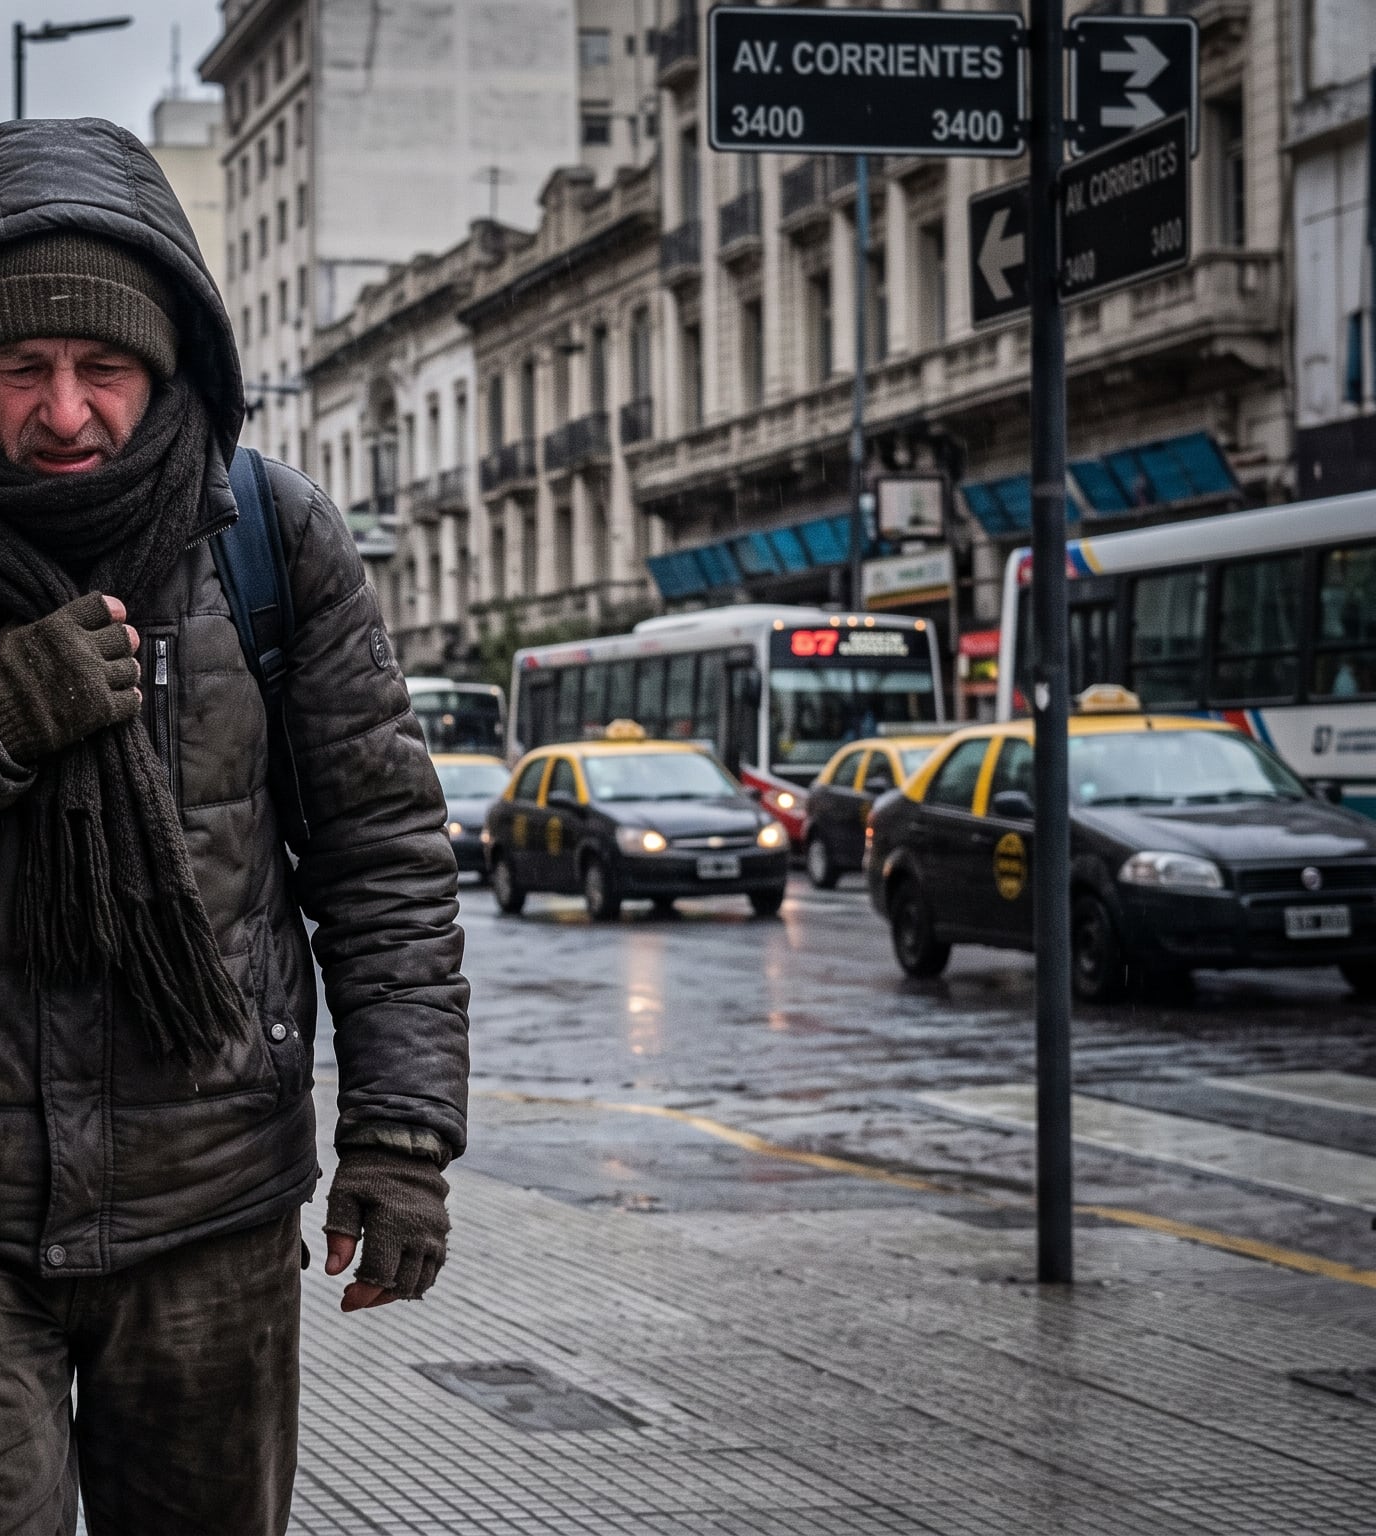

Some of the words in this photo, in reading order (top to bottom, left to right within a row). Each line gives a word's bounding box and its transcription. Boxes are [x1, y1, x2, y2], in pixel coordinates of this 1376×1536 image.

[732, 40, 782, 74] AV.
[792, 41, 1003, 79] CORRIENTES
[731, 105, 804, 138] 3400
[931, 109, 1003, 142] 3400
[1089, 141, 1177, 207] CORRIENTES
[1151, 217, 1182, 258] 3400
